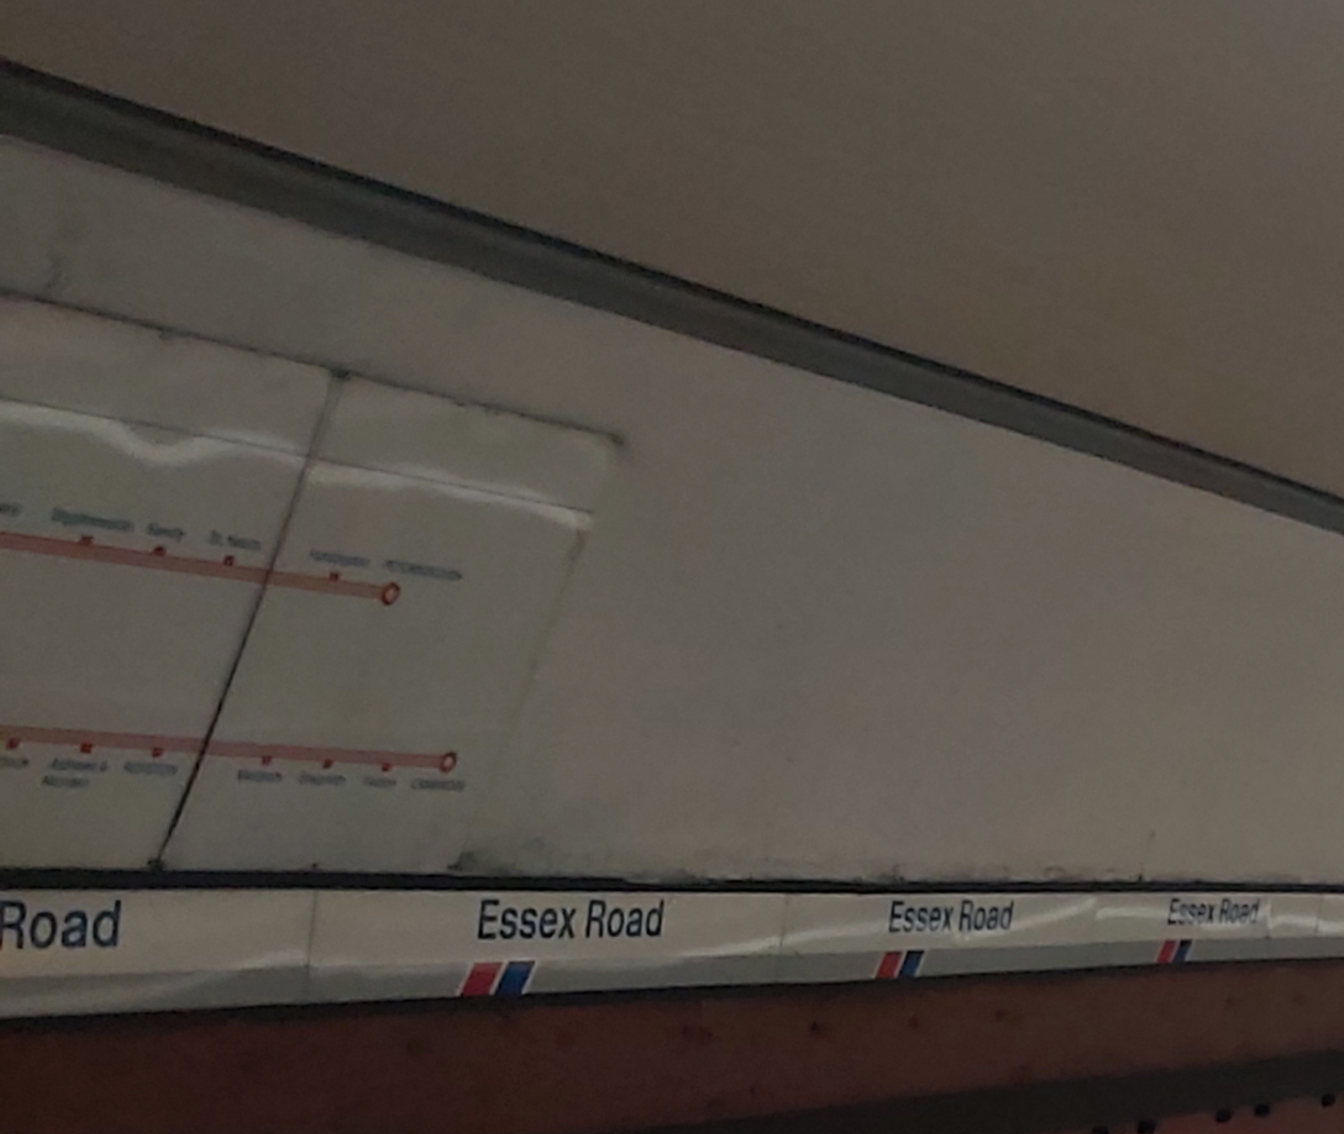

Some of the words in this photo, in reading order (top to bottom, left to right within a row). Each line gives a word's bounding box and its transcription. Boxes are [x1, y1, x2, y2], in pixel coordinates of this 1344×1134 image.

[0, 899, 121, 948] Road
[478, 899, 576, 939] Essex
[586, 899, 664, 938] Road
[888, 900, 953, 933] Essex
[959, 899, 1014, 931] Road
